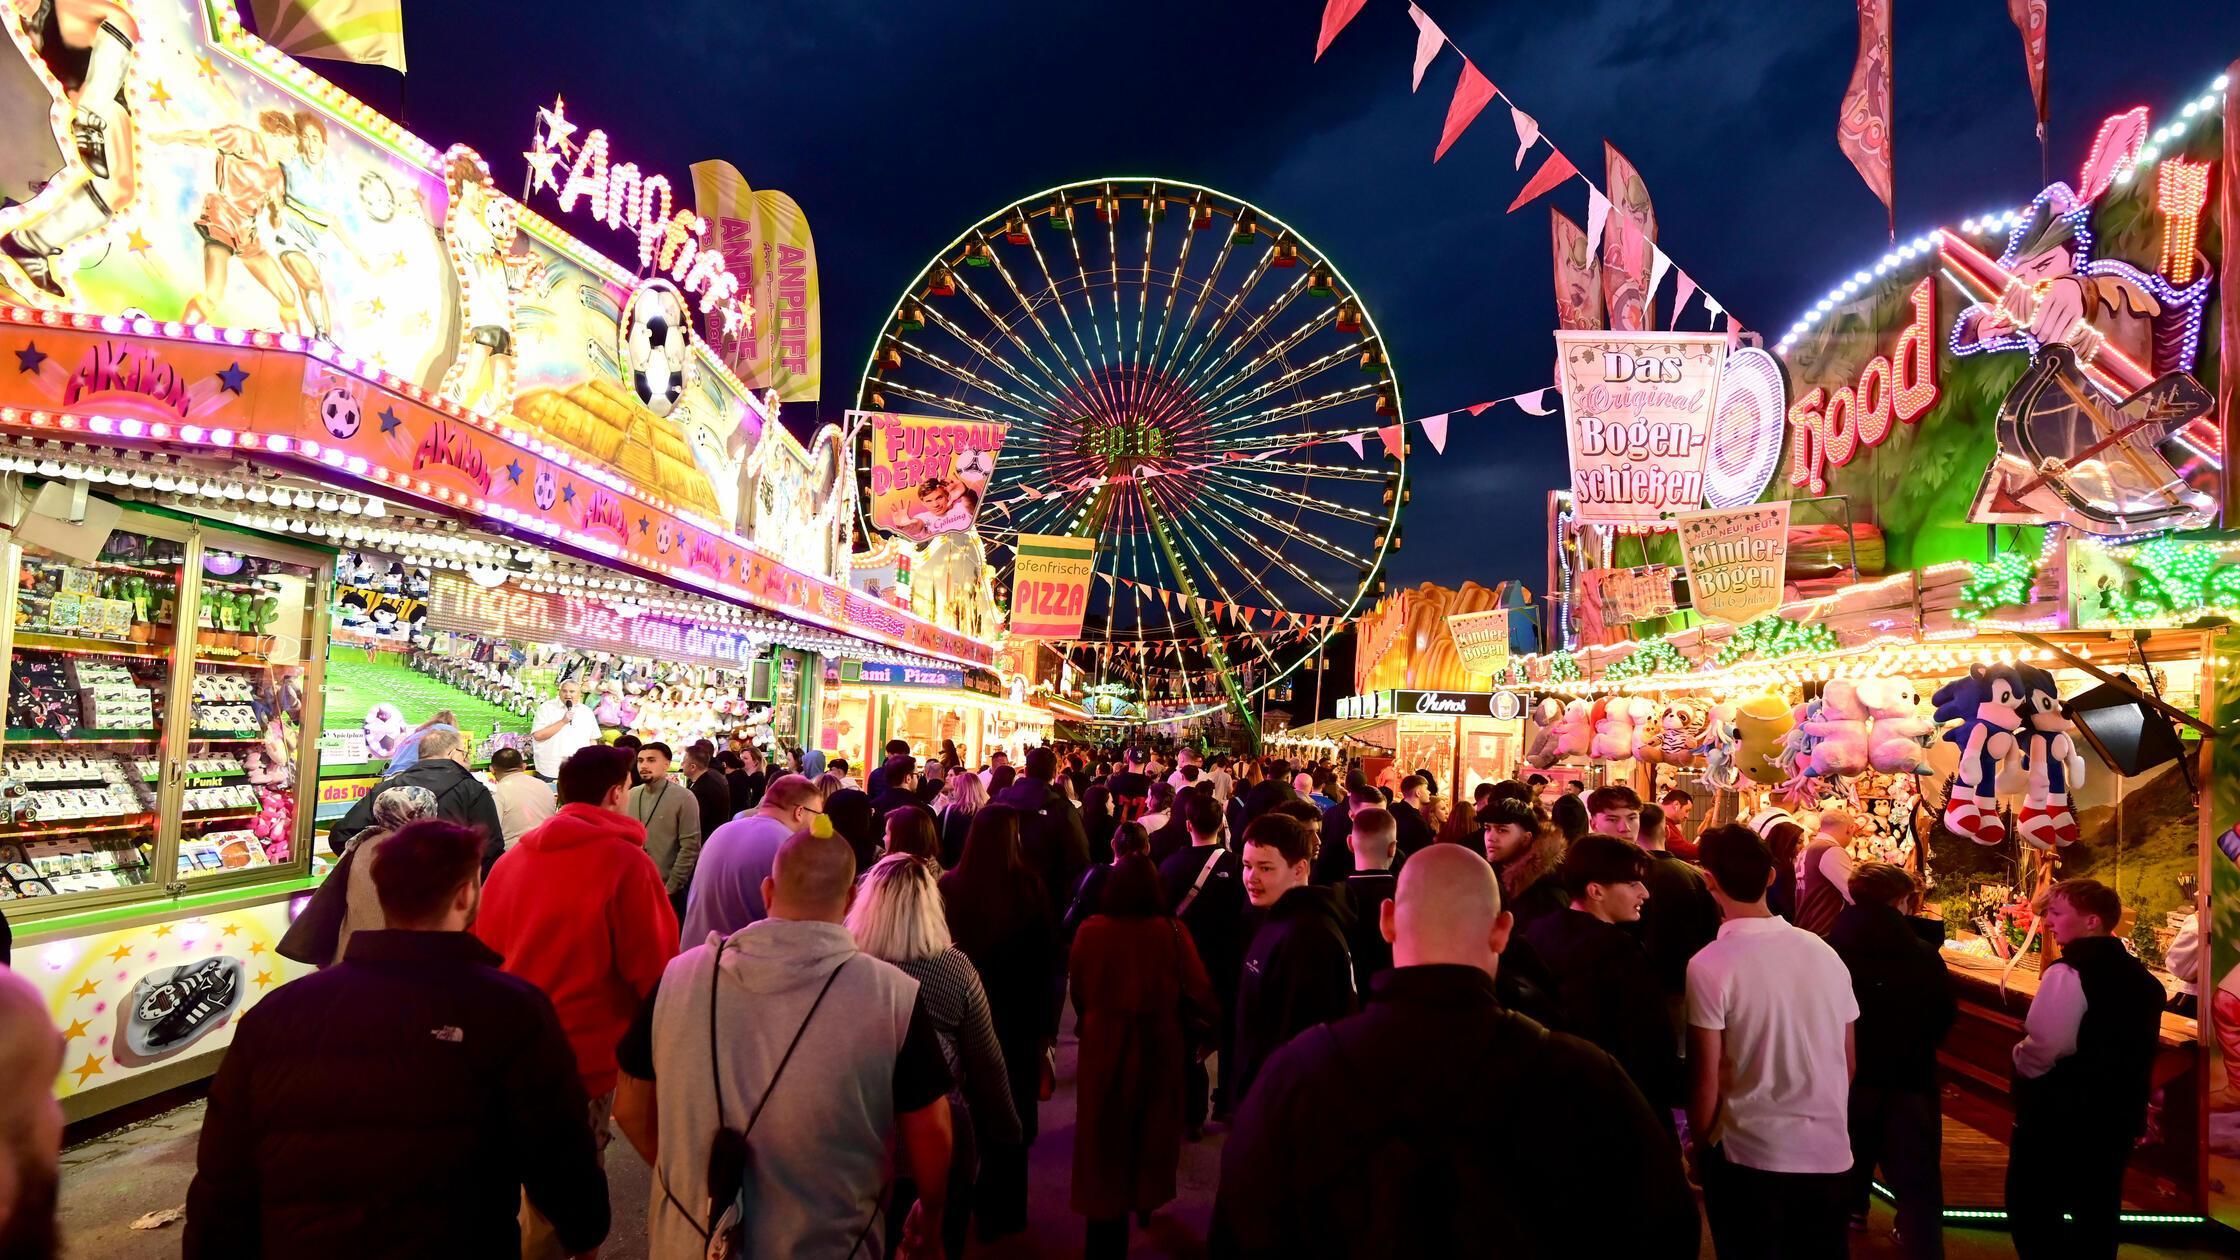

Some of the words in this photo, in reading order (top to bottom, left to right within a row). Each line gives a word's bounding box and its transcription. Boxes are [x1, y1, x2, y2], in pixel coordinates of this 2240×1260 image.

[777, 243, 807, 375] ANPFIFF
[1603, 351, 1683, 383] Das
[1579, 383, 1706, 416] Original
[886, 424, 1006, 462] FUSSBALL-
[1578, 416, 1706, 461] Bogen-
[872, 455, 953, 496] DERBY
[1575, 463, 1703, 509] schießen
[1720, 524, 1743, 537] NEU!
[1746, 519, 1772, 534] NEU!
[1017, 560, 1089, 576] ofenfrische
[1693, 536, 1784, 571] Kinder-
[1015, 580, 1085, 617] PIZZA
[1697, 565, 1776, 599] Bögen
[1458, 629, 1507, 647] Kinder-
[1463, 643, 1505, 662] Bögen
[861, 667, 891, 682] ami
[904, 668, 947, 684] Pizza
[193, 777, 223, 787] Punkt
[324, 785, 348, 801] das
